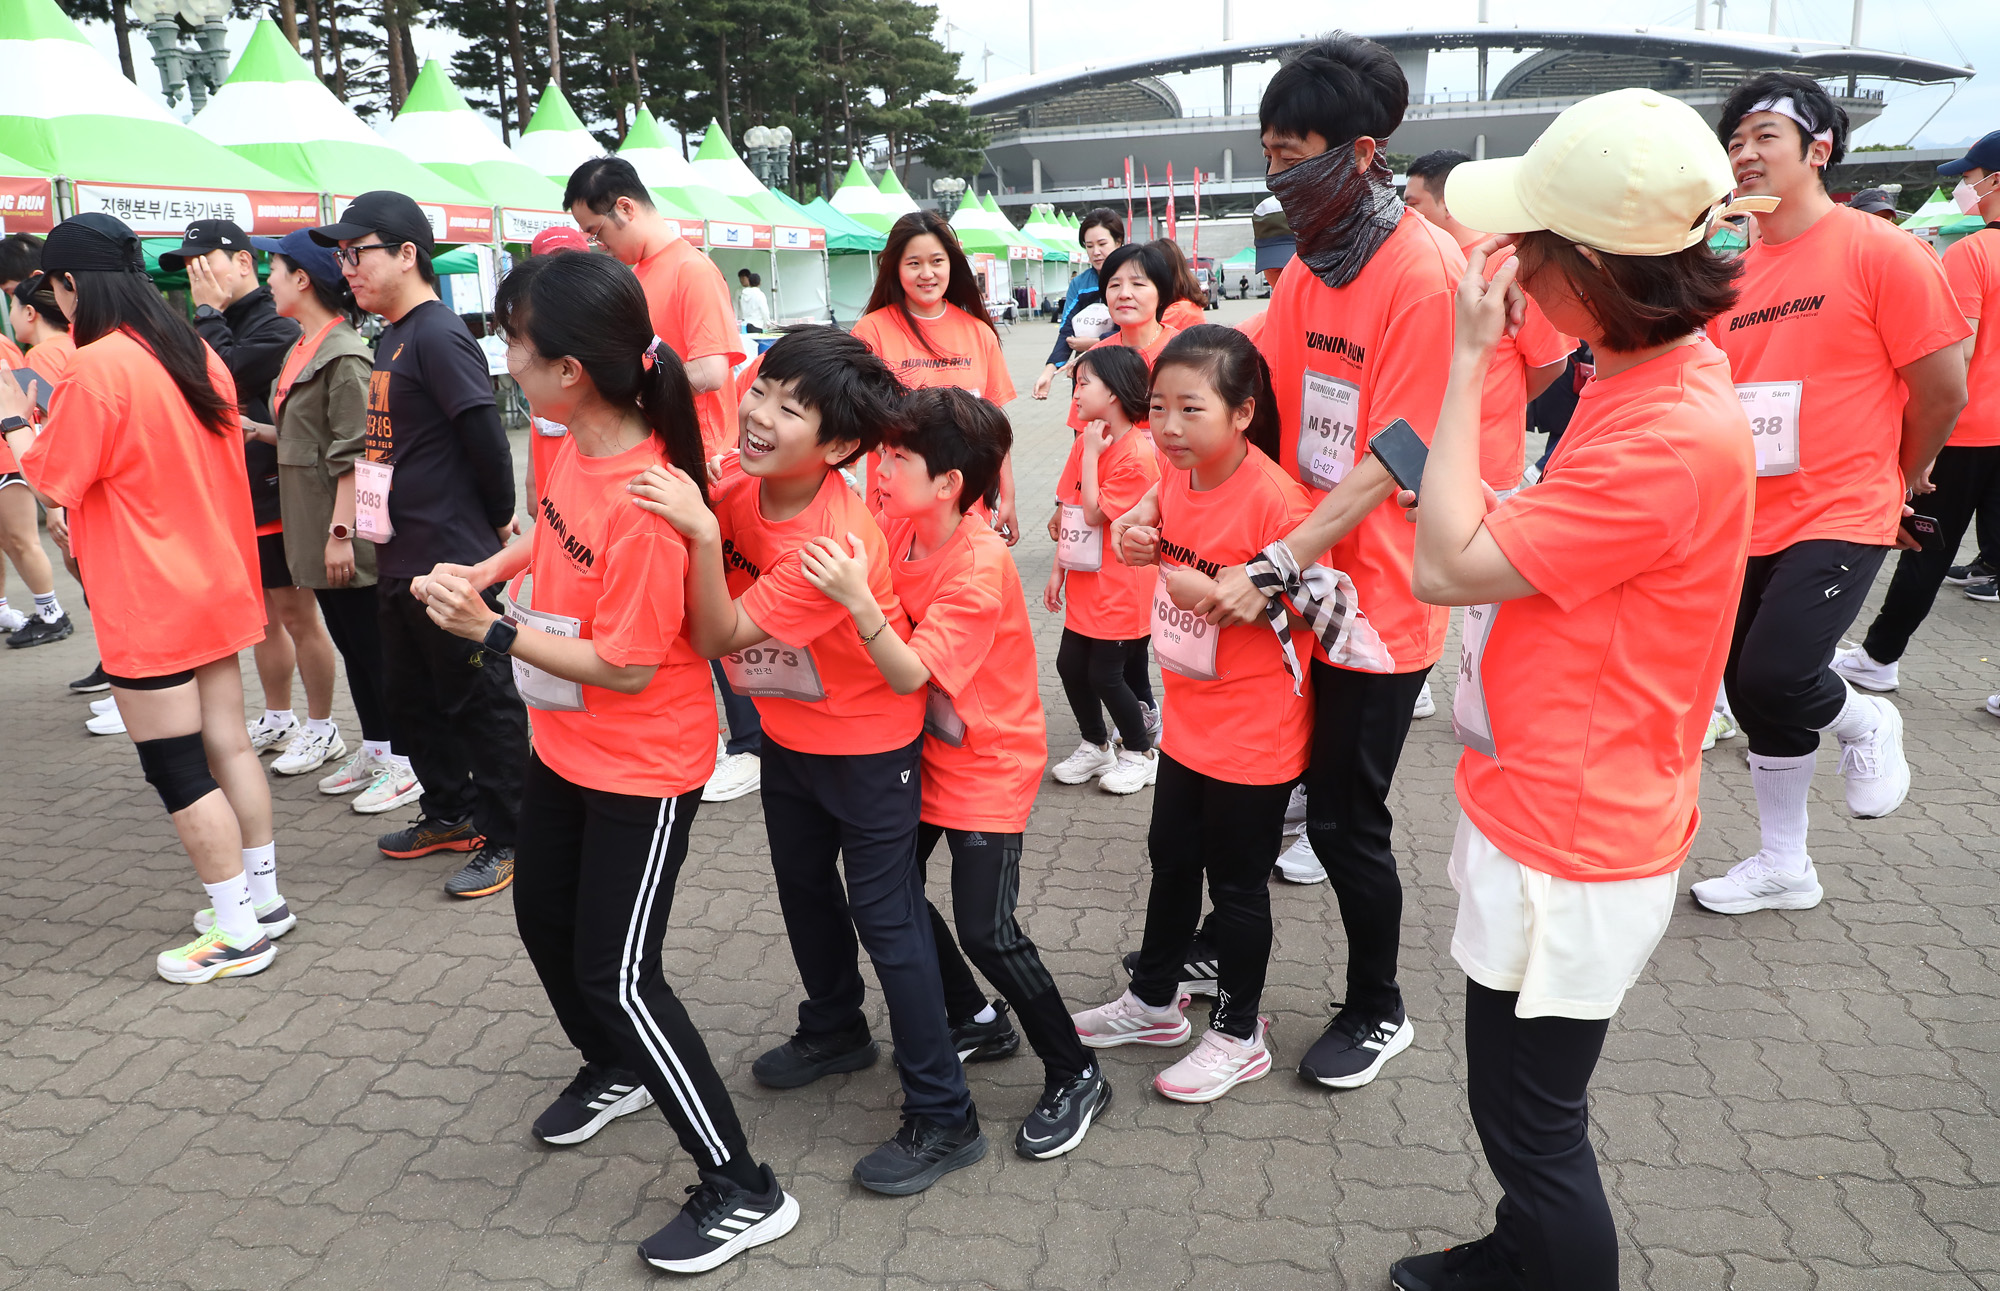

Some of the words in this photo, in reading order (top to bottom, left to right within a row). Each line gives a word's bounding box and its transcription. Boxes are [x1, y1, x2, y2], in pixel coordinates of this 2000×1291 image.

[17, 195, 46, 210] RUN
[257, 204, 300, 218] BURNING
[300, 205, 317, 218] RUN
[1788, 294, 1826, 314] RUN
[1347, 341, 1366, 364] RUN
[1309, 381, 1336, 397] BURNING
[1335, 388, 1351, 402] RUN
[1771, 390, 1791, 399] 5km
[1308, 414, 1319, 431] M
[1313, 458, 1335, 475] D-427
[356, 488, 382, 509] 5083
[563, 534, 595, 568] RUN
[511, 610, 529, 627] RUN
[544, 625, 567, 637] 5km
[1158, 600, 1207, 639] 6080
